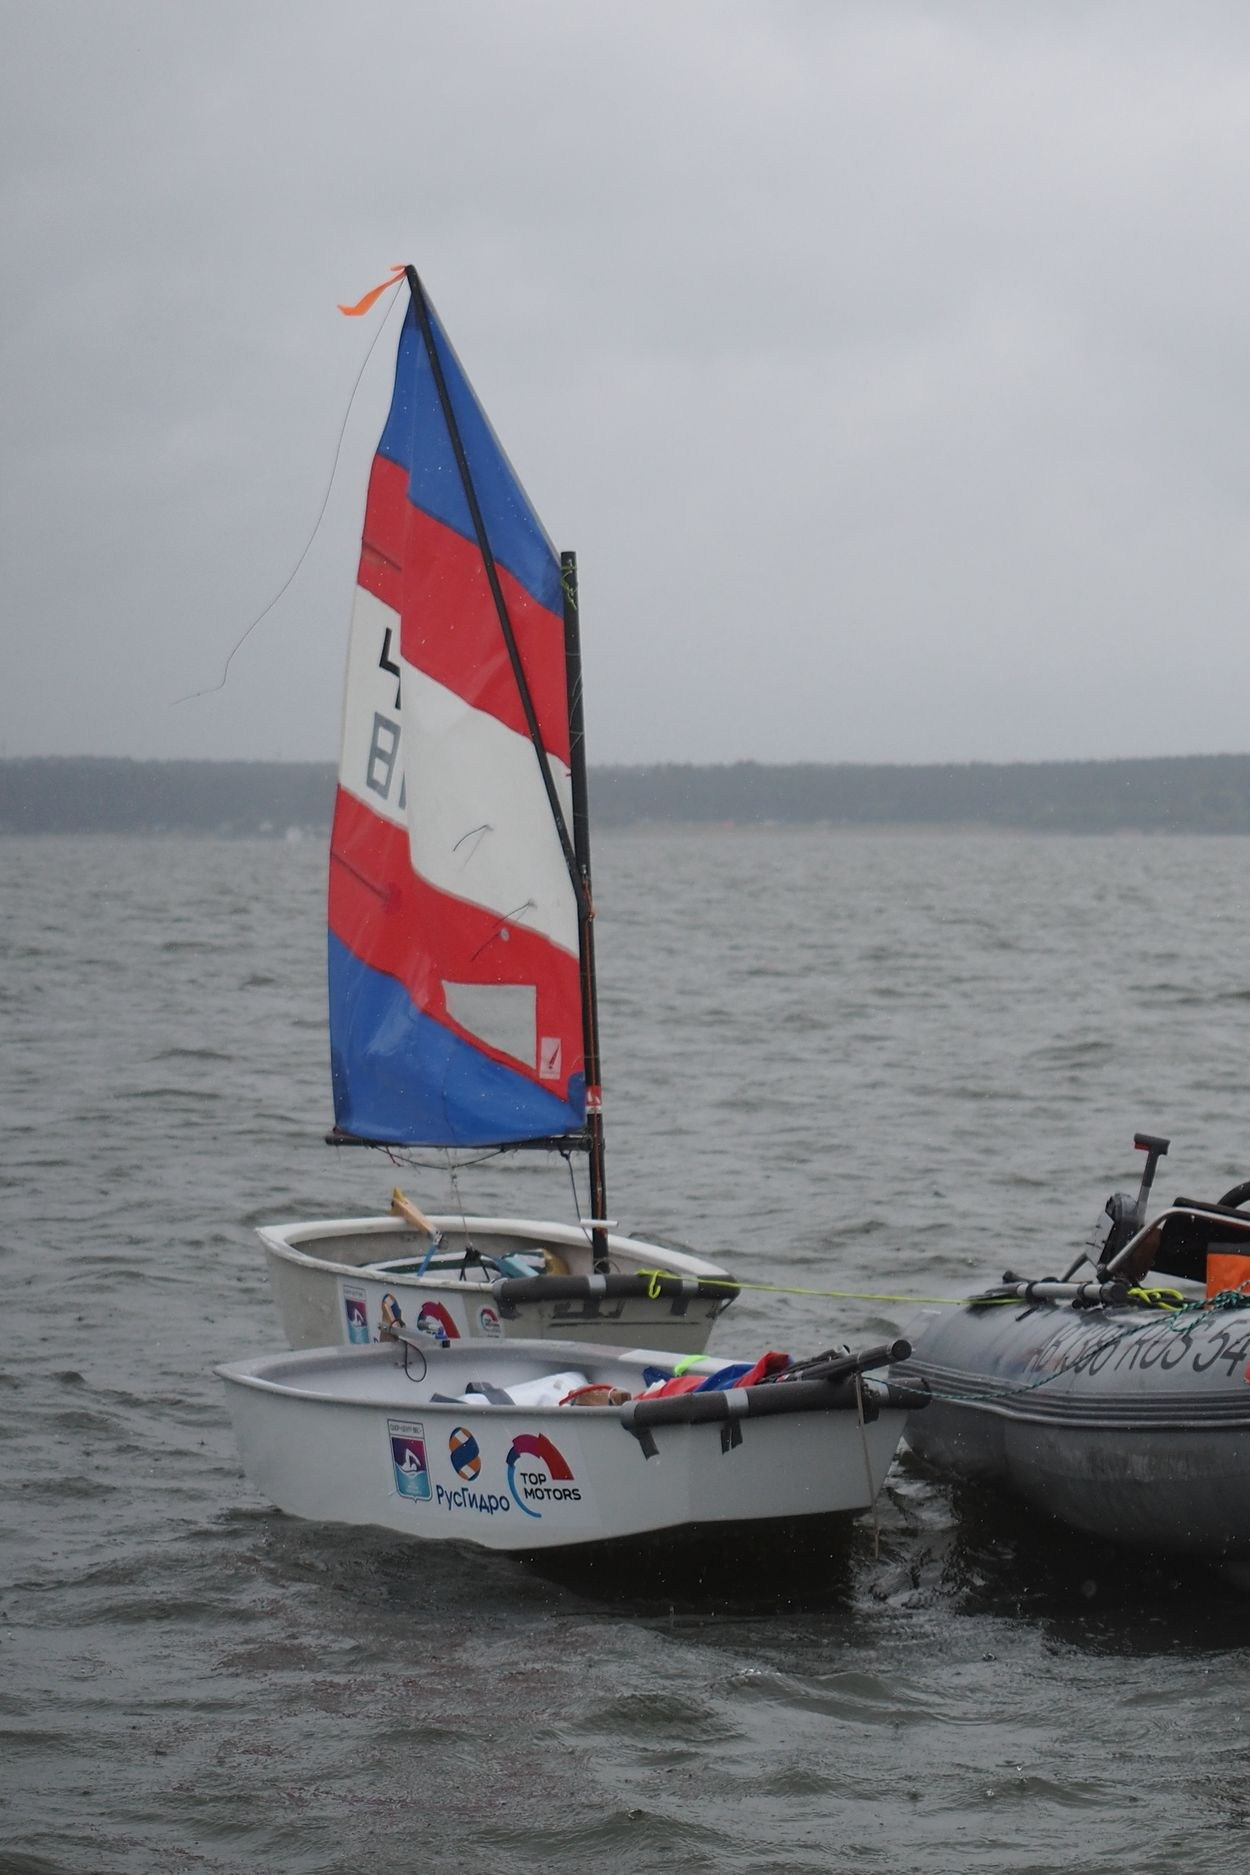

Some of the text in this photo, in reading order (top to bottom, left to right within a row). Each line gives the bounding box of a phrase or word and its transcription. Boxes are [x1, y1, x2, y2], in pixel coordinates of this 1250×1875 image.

[1114, 1319, 1217, 1371] RUS
[520, 1472, 547, 1485] TOP
[436, 1484, 510, 1515] РусГидро
[524, 1487, 582, 1501] MOTORS
